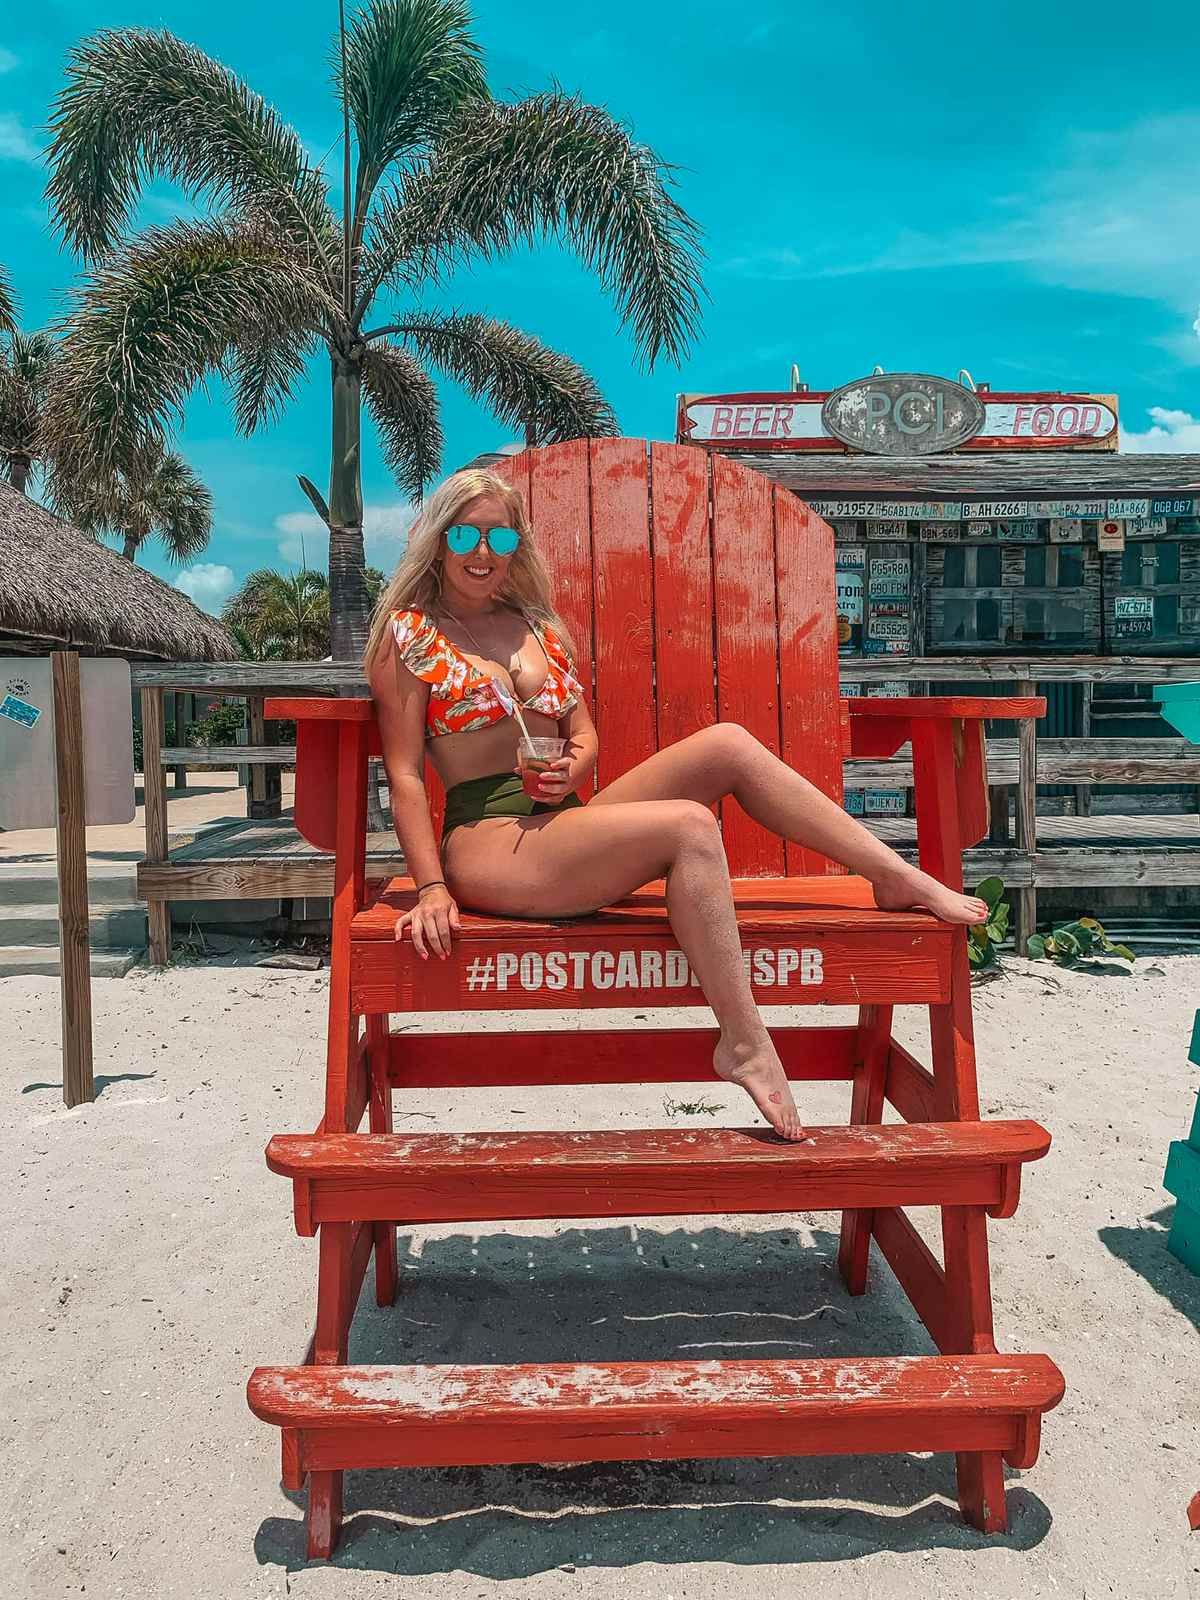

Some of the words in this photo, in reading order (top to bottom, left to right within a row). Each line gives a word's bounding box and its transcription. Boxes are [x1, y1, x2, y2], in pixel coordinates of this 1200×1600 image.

[710, 406, 794, 437] BEER
[865, 391, 945, 435] PCI
[1012, 405, 1102, 436] FOOD
[963, 504, 970, 517] B
[978, 504, 992, 517] AH
[994, 502, 1020, 516] 6266
[465, 949, 824, 992] #POSTCARDSPB
